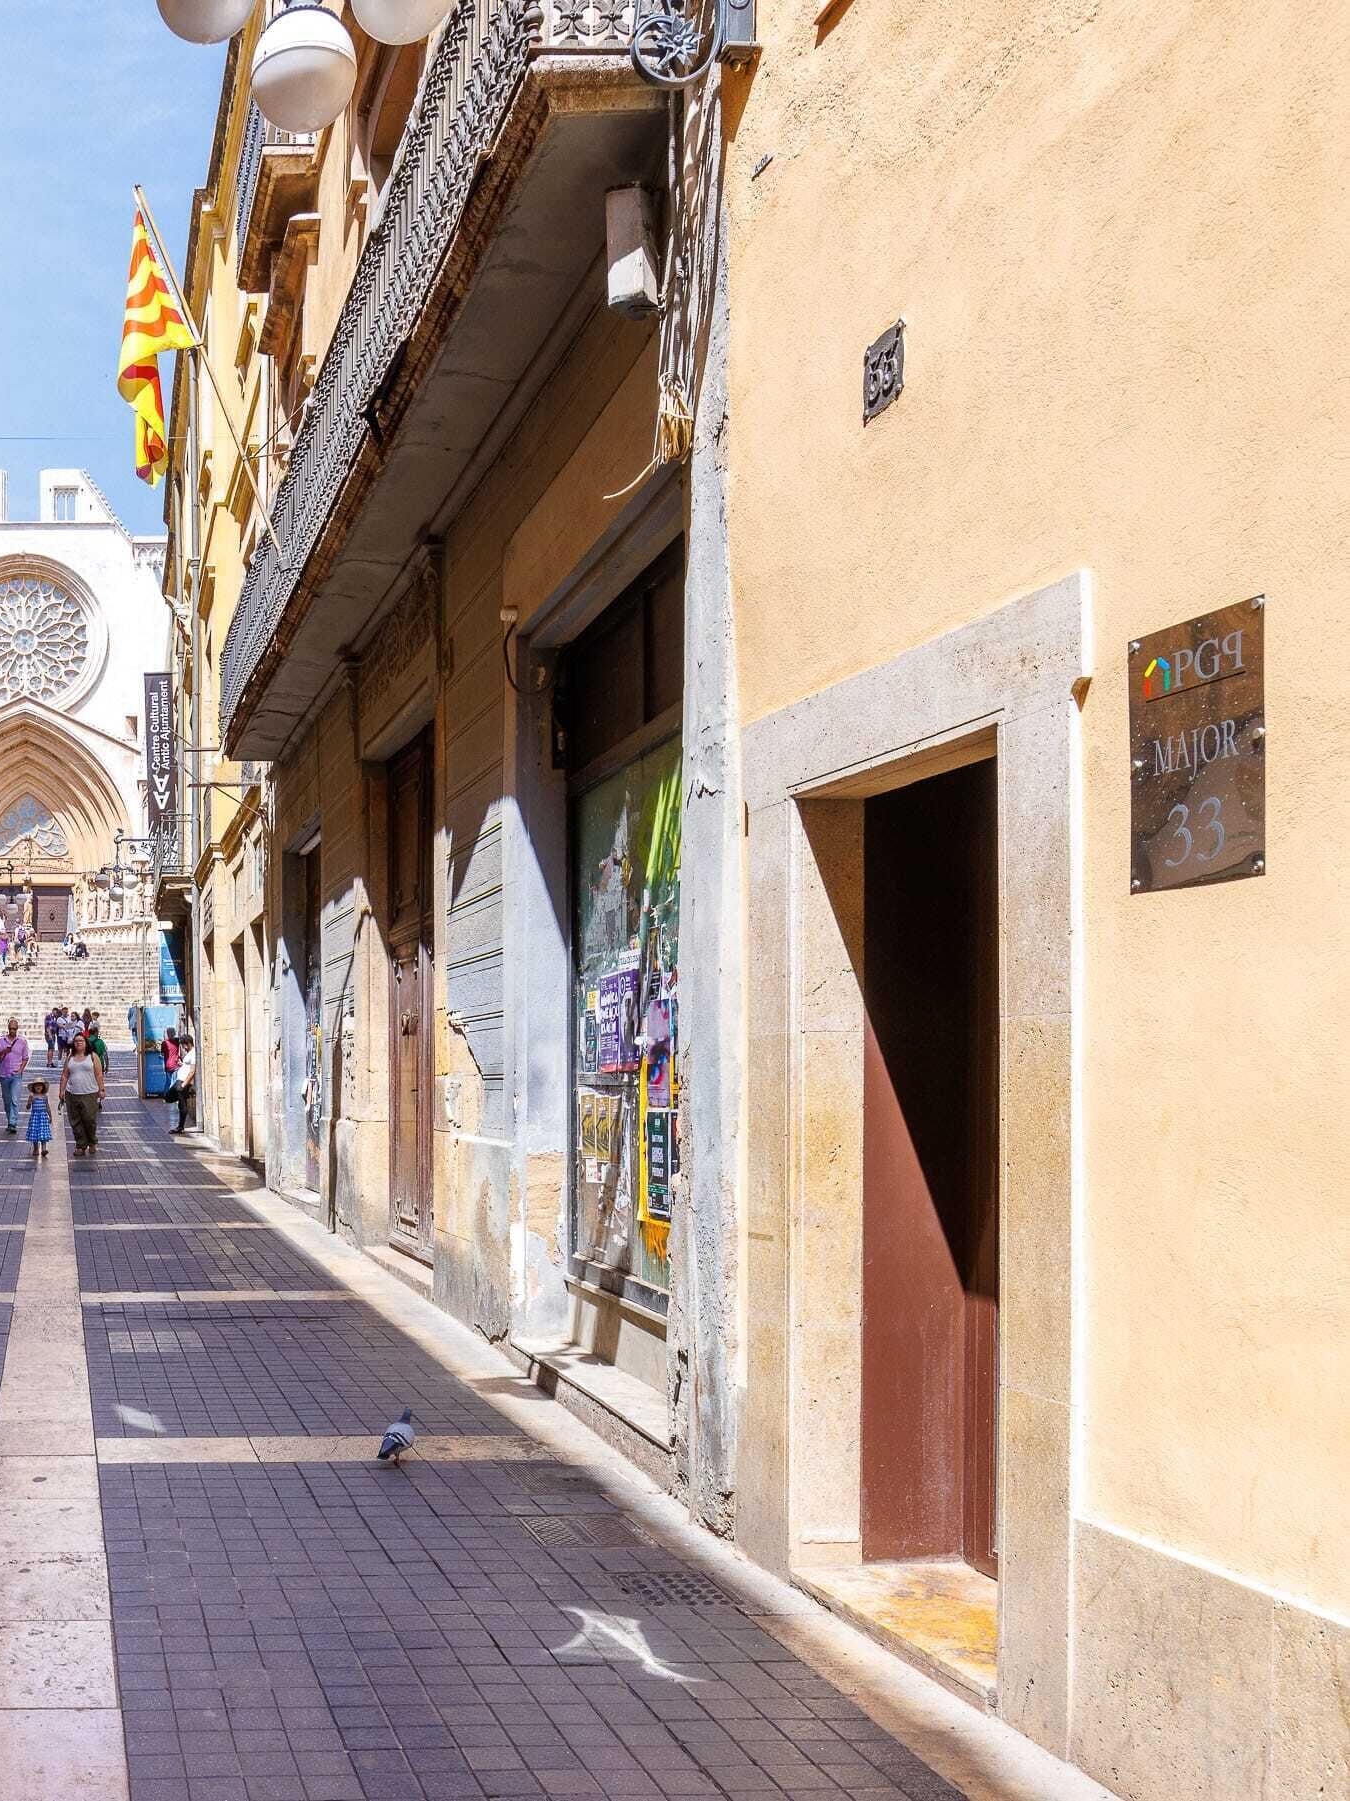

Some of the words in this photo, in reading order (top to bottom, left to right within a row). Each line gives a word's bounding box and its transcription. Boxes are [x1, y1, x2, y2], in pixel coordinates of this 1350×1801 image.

[159, 680, 170, 740] Ajuntament
[152, 735, 160, 771] Centre
[161, 743, 170, 769] Antic
[1153, 719, 1239, 781] MAJOR
[1165, 796, 1226, 868] 33
